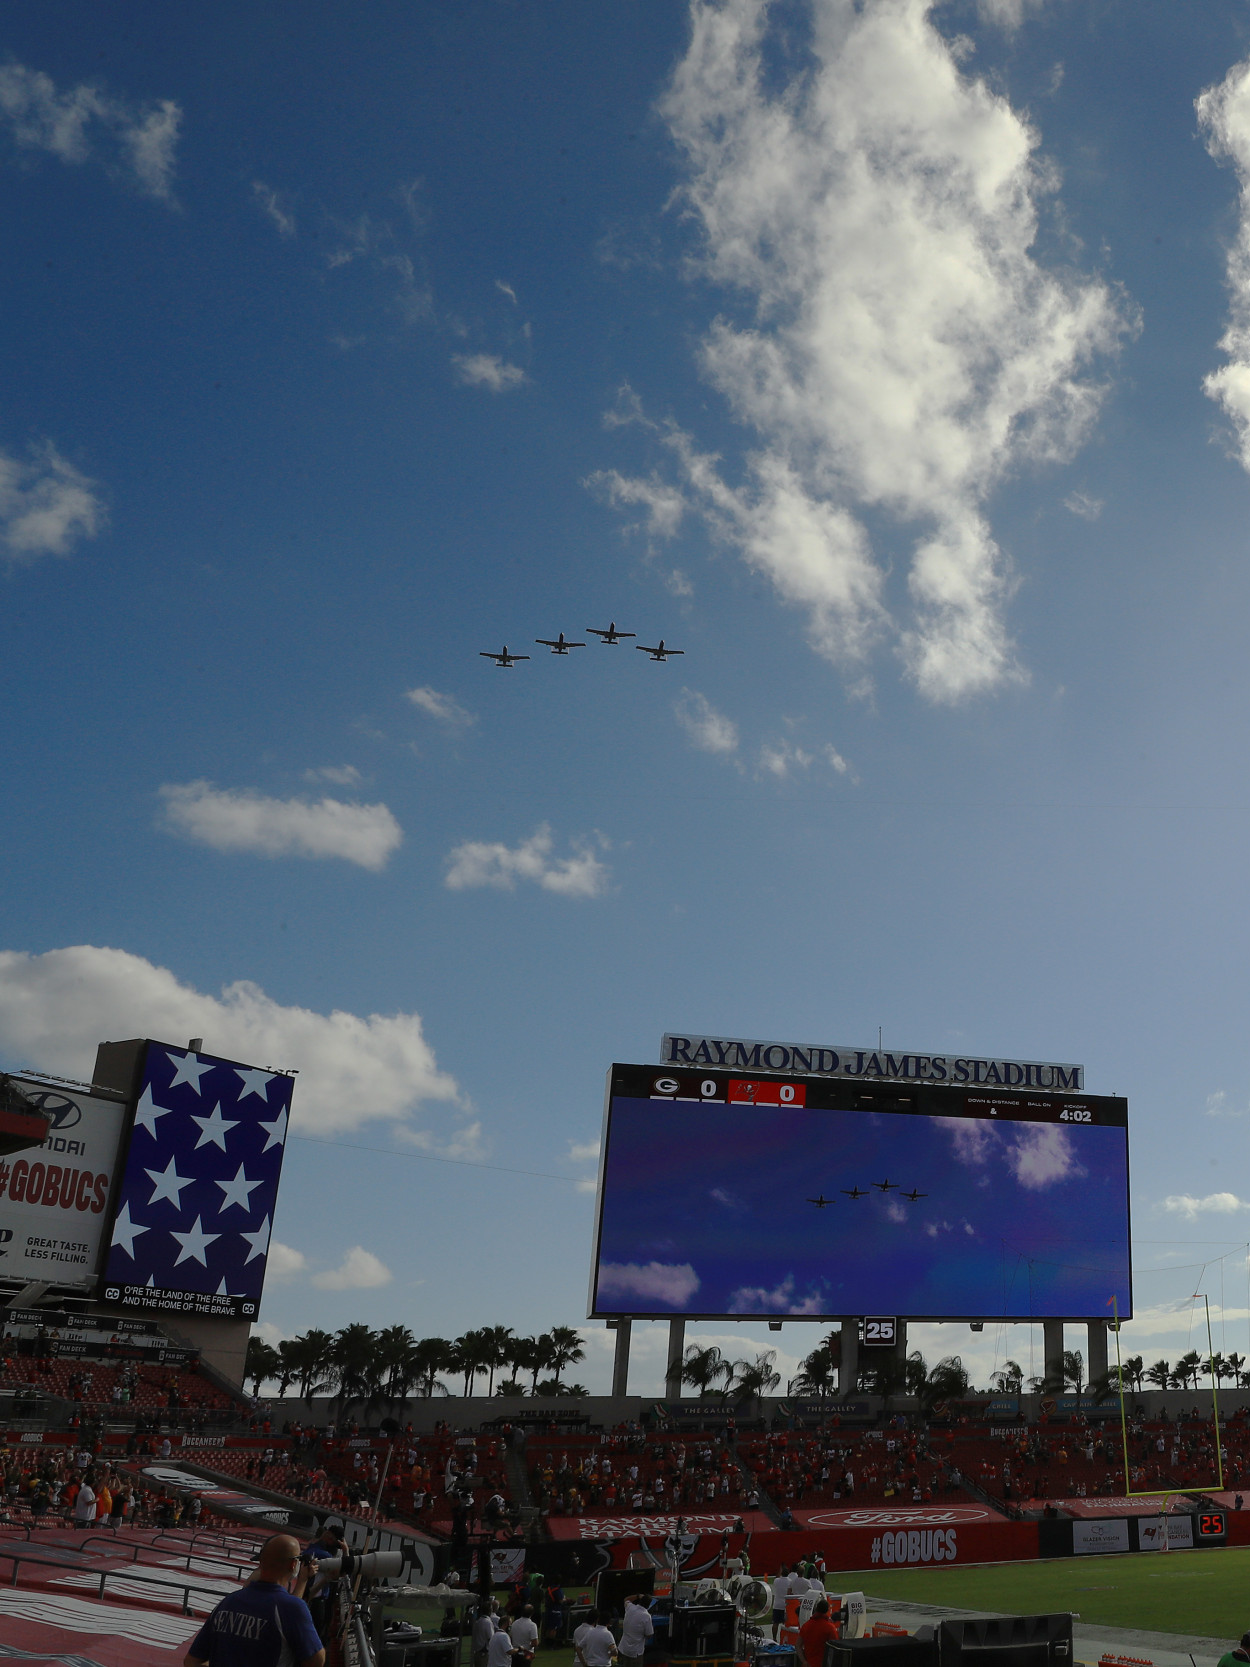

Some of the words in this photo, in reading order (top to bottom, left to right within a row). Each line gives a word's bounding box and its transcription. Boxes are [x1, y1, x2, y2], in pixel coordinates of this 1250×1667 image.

[667, 1037, 840, 1072] RAYMOND
[846, 1052, 947, 1080] JAMES
[953, 1059, 1081, 1090] STADIUM
[701, 1080, 718, 1097] 0
[780, 1085, 795, 1102] 0
[1059, 1109, 1092, 1122] 4:02
[0, 1159, 108, 1214] #GOBUCS
[27, 1237, 57, 1249] GREAT
[60, 1241, 90, 1253] TASTE.
[25, 1248, 48, 1260] LESS
[51, 1252, 88, 1264] FILLING.
[122, 1295, 140, 1306] AND
[141, 1297, 157, 1307] THE
[158, 1298, 181, 1311] HOME
[182, 1301, 194, 1312] OF
[195, 1302, 210, 1313] THE
[211, 1303, 236, 1316] BRAVE
[145, 1288, 160, 1299] THE
[161, 1290, 182, 1302] LAND
[183, 1292, 195, 1302] OF
[196, 1293, 211, 1304] THE
[212, 1294, 232, 1306] FREE
[867, 1324, 893, 1339] 25
[843, 1510, 957, 1525] Ford
[1202, 1515, 1223, 1534] 25
[870, 1529, 957, 1564] #GOBUCS
